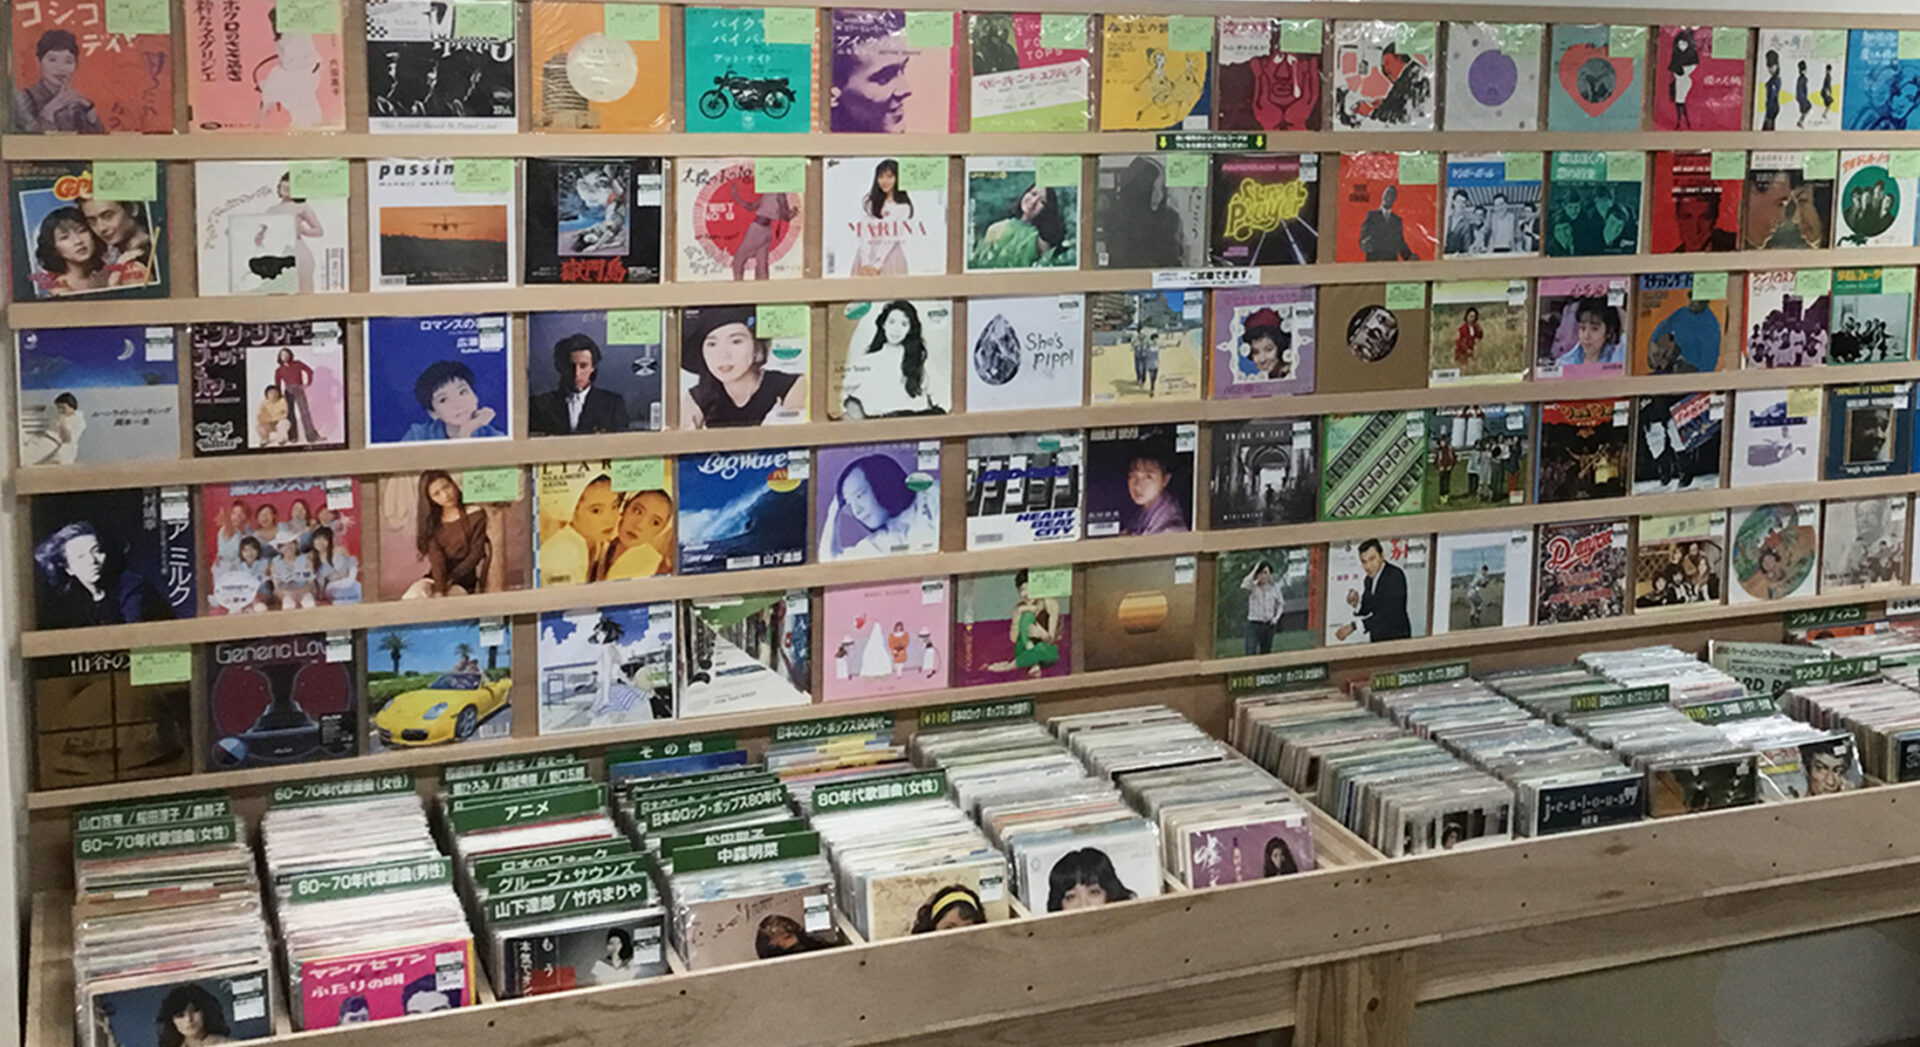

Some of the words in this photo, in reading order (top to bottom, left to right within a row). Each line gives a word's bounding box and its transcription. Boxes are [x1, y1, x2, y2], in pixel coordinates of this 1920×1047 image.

[848, 221, 927, 238] MARINA
[420, 318, 479, 330] ロマンスの
[1016, 509, 1076, 522] HEART
[1031, 518, 1075, 529] BEAT
[1034, 526, 1074, 537] CITY
[215, 643, 292, 664] Generic
[640, 741, 703, 759] その他
[504, 800, 550, 821] アニメ
[717, 841, 779, 864] 中森明菜
[495, 893, 556, 919] 山下達郎
[572, 882, 642, 908] 竹内まりや
